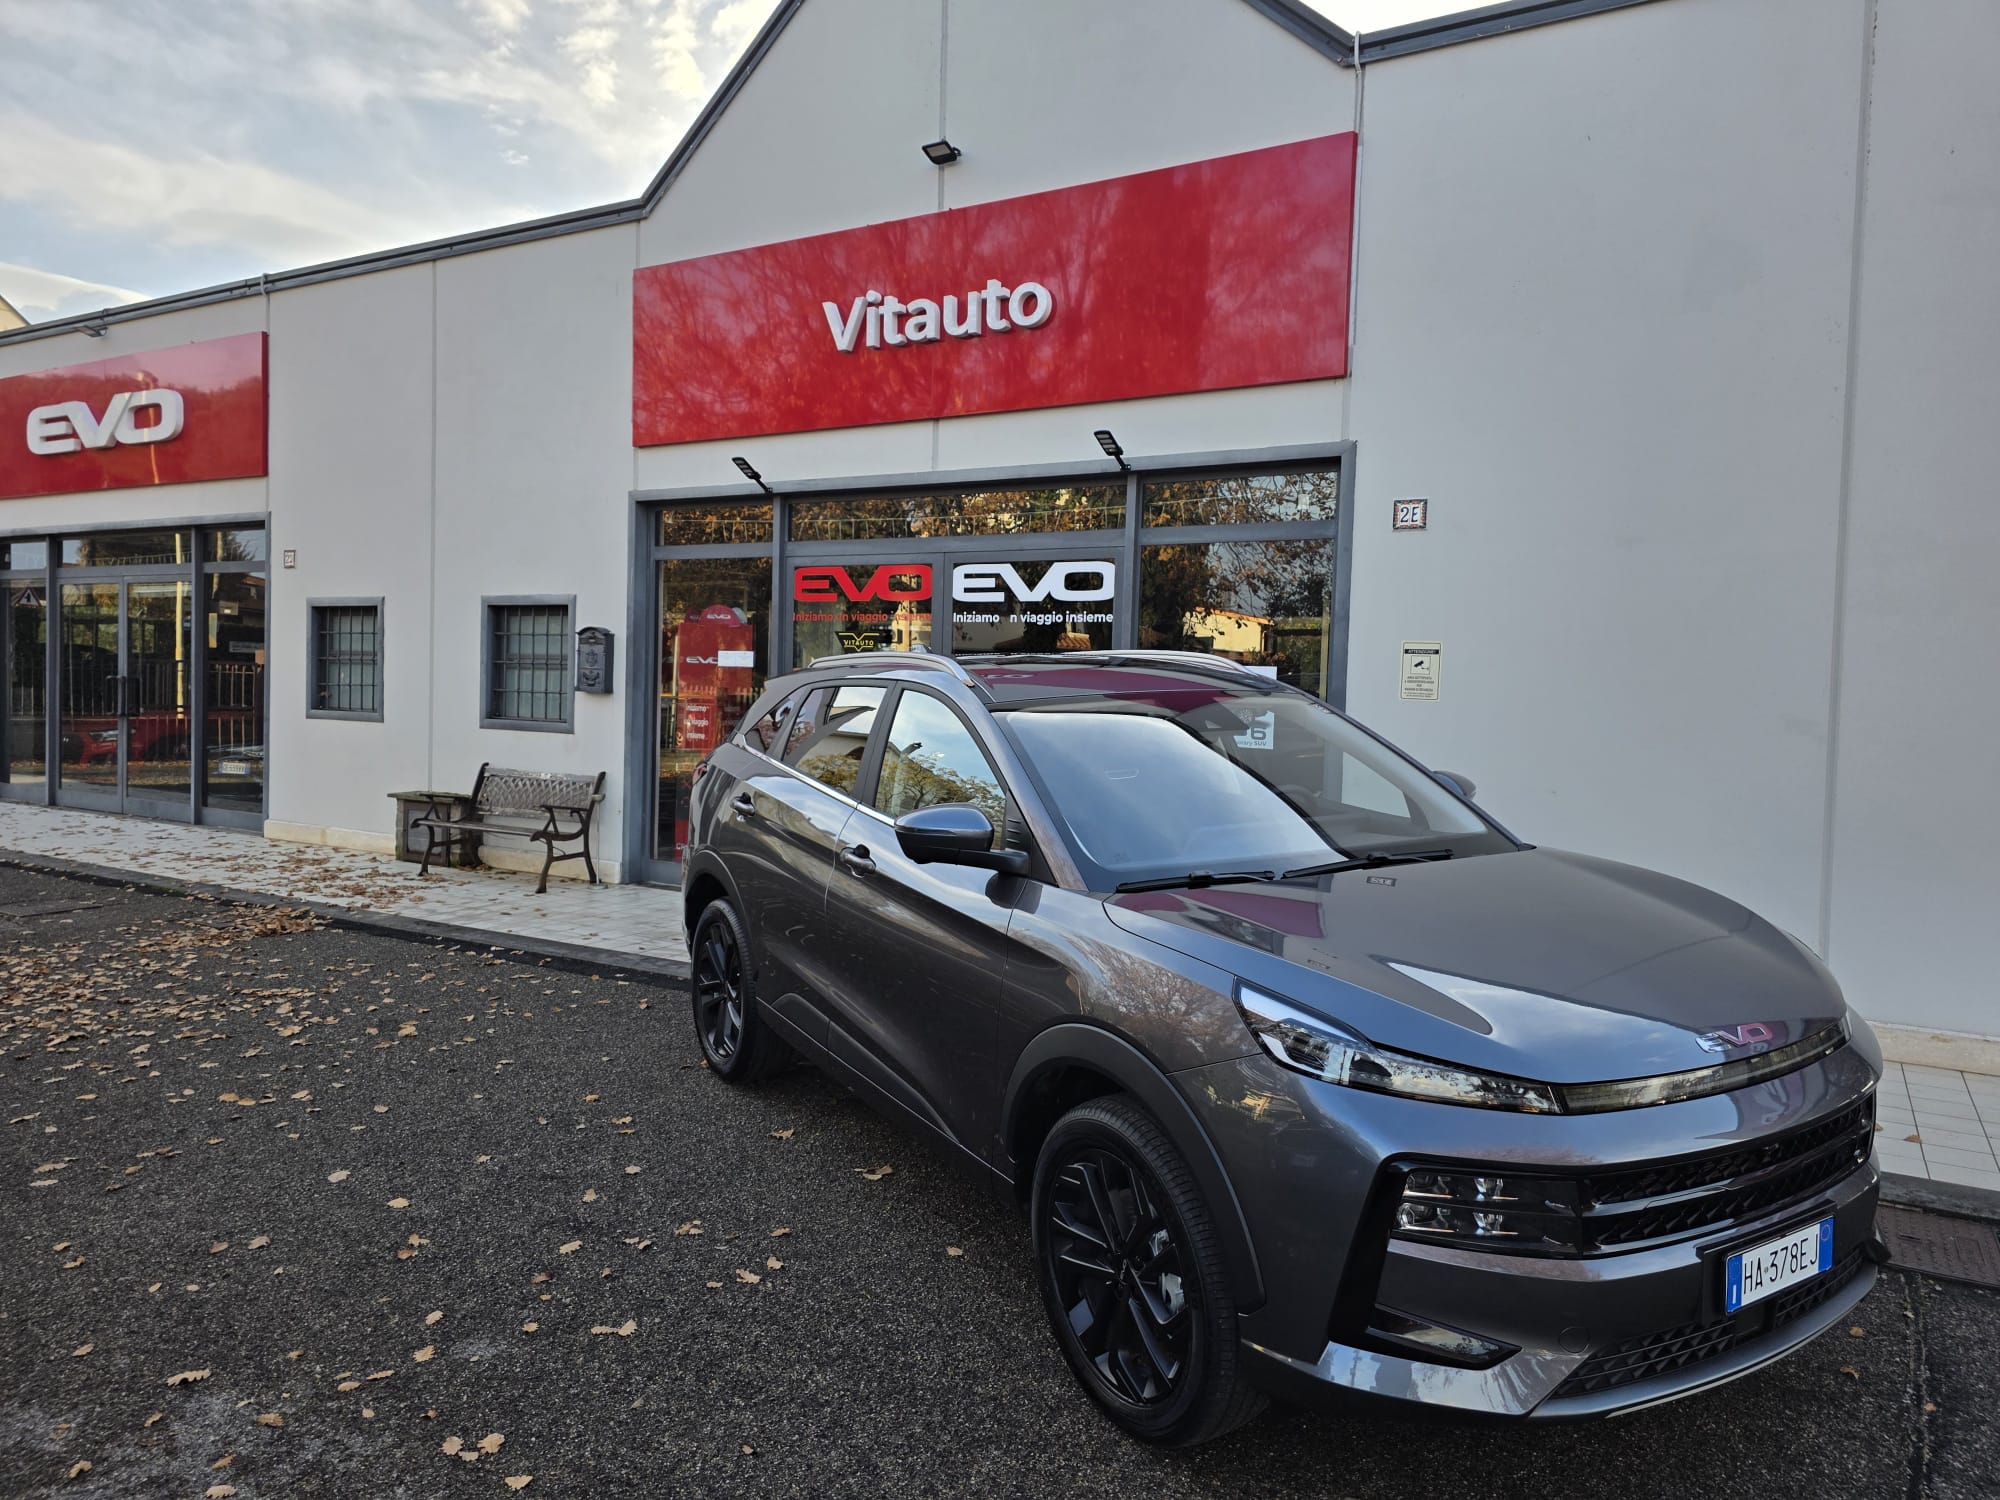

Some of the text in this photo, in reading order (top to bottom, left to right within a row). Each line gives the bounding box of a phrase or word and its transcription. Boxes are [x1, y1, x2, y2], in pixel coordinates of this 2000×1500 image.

[822, 279, 1053, 352] Vitauto
[27, 388, 185, 455] EVO
[1400, 506, 1420, 523] 2E
[794, 564, 933, 602] EVO
[952, 561, 1116, 603] EVO
[851, 610, 889, 623] viaggio
[953, 611, 1000, 623] Iniziamo
[1020, 611, 1063, 625] viaggio
[1065, 610, 1114, 623] insieme
[1695, 1022, 1774, 1053] EVO
